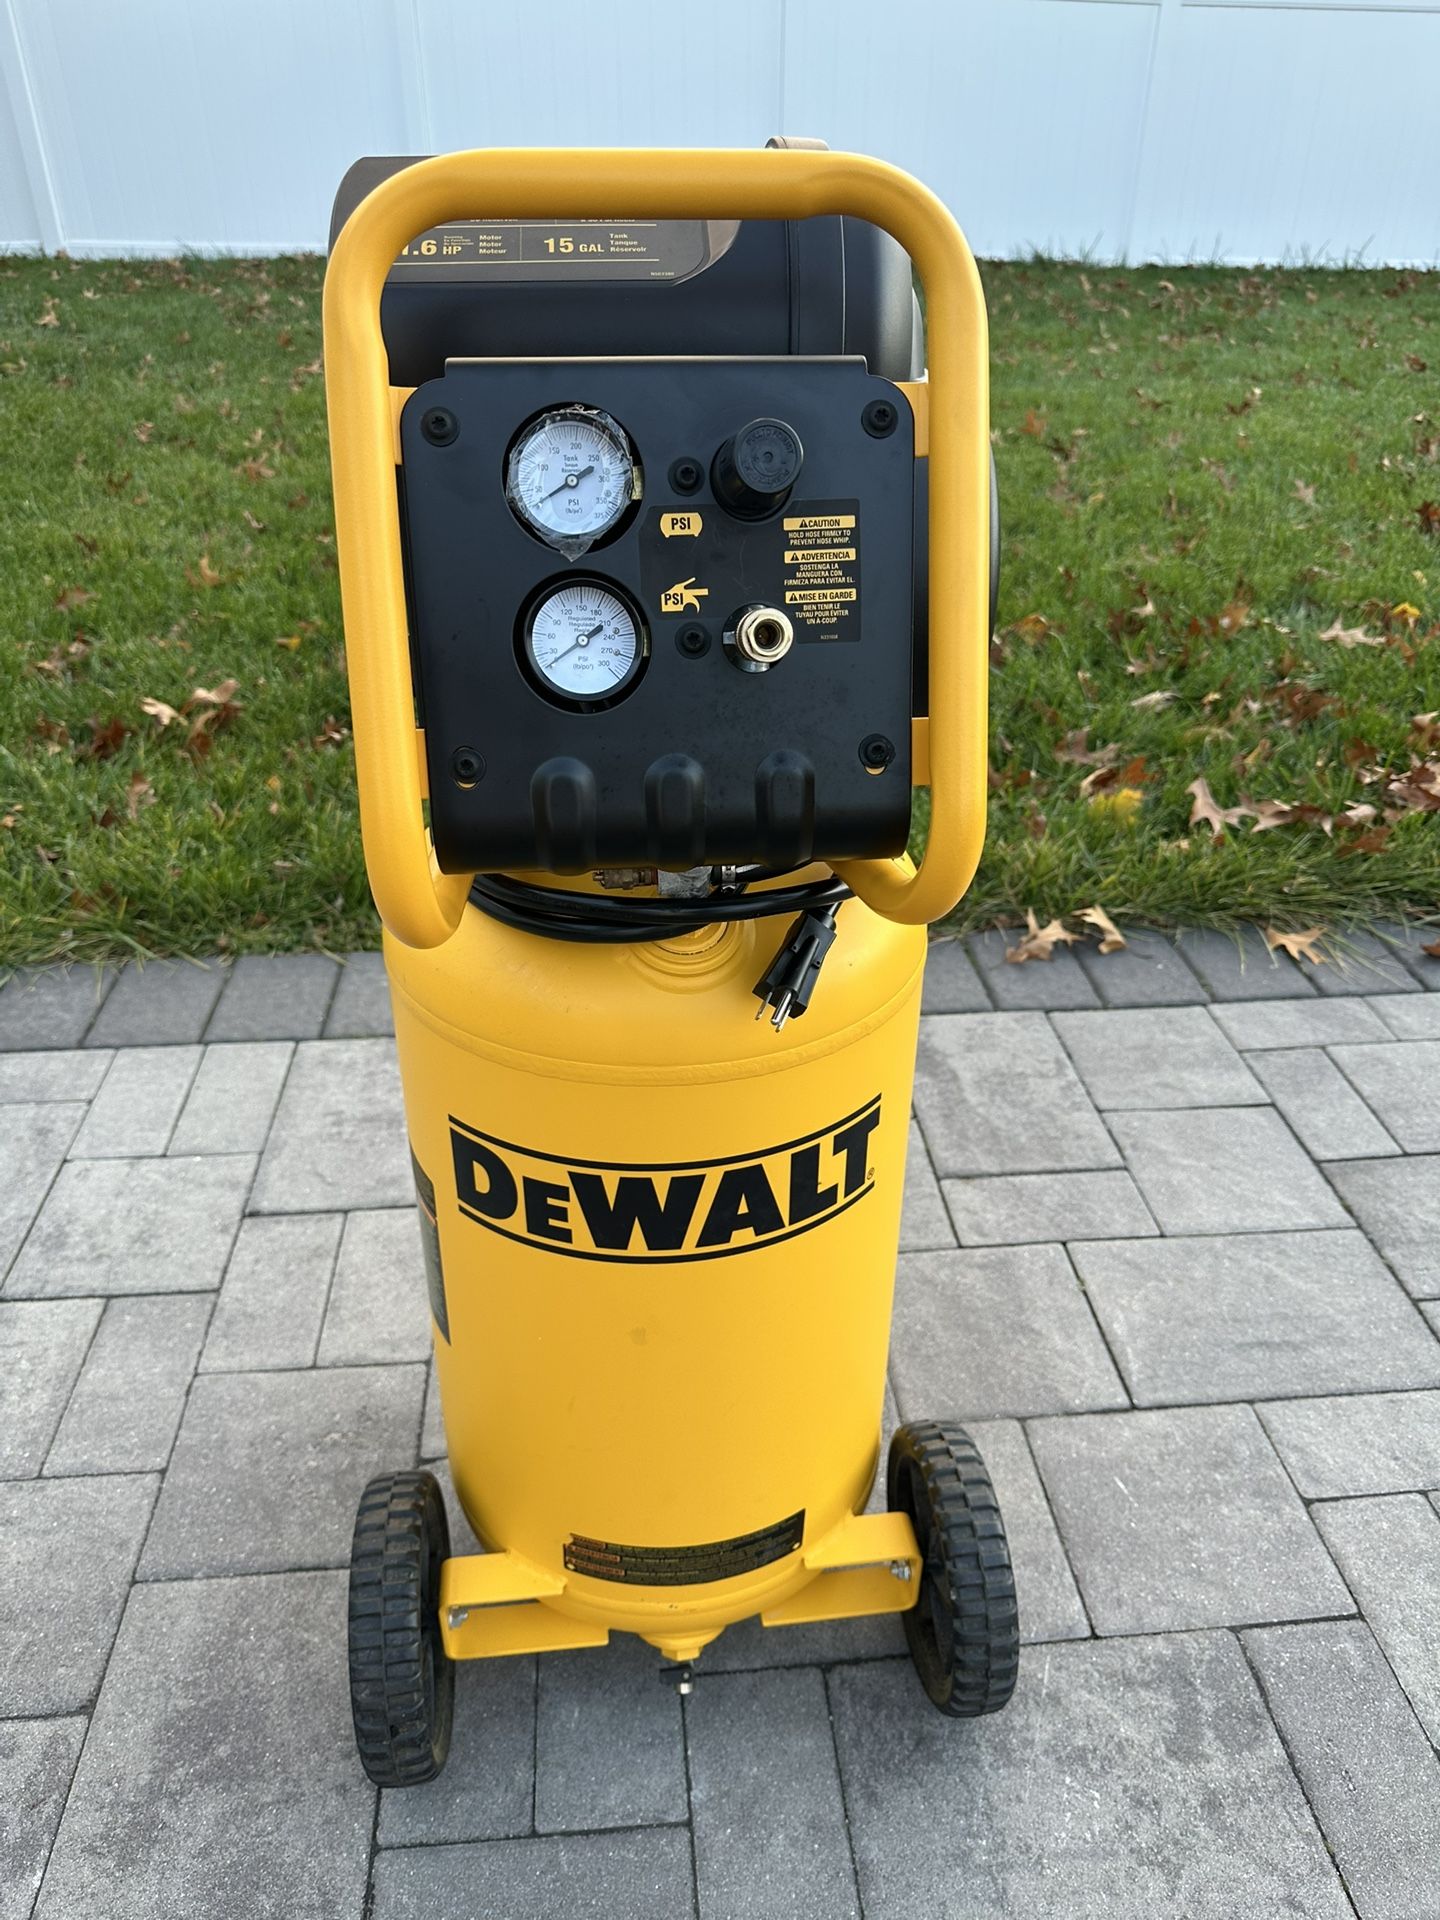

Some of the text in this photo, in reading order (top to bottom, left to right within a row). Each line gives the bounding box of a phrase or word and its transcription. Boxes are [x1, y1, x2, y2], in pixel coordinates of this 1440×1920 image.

[544, 237, 605, 253] 15 GAL
[443, 246, 461, 255] HP
[548, 446, 560, 455] 150
[570, 442, 582, 450] 200
[587, 454, 600, 462] 250
[568, 498, 580, 506] PSI
[671, 517, 691, 530] PSI
[808, 519, 841, 528] CAUTION
[788, 531, 804, 539] HOLD
[801, 551, 851, 561] ADVERTENCIA
[800, 563, 831, 571] SOSTENGA
[664, 592, 684, 605] PSI
[818, 592, 828, 600] EN
[829, 591, 853, 599] GARDE
[598, 659, 610, 667] 300
